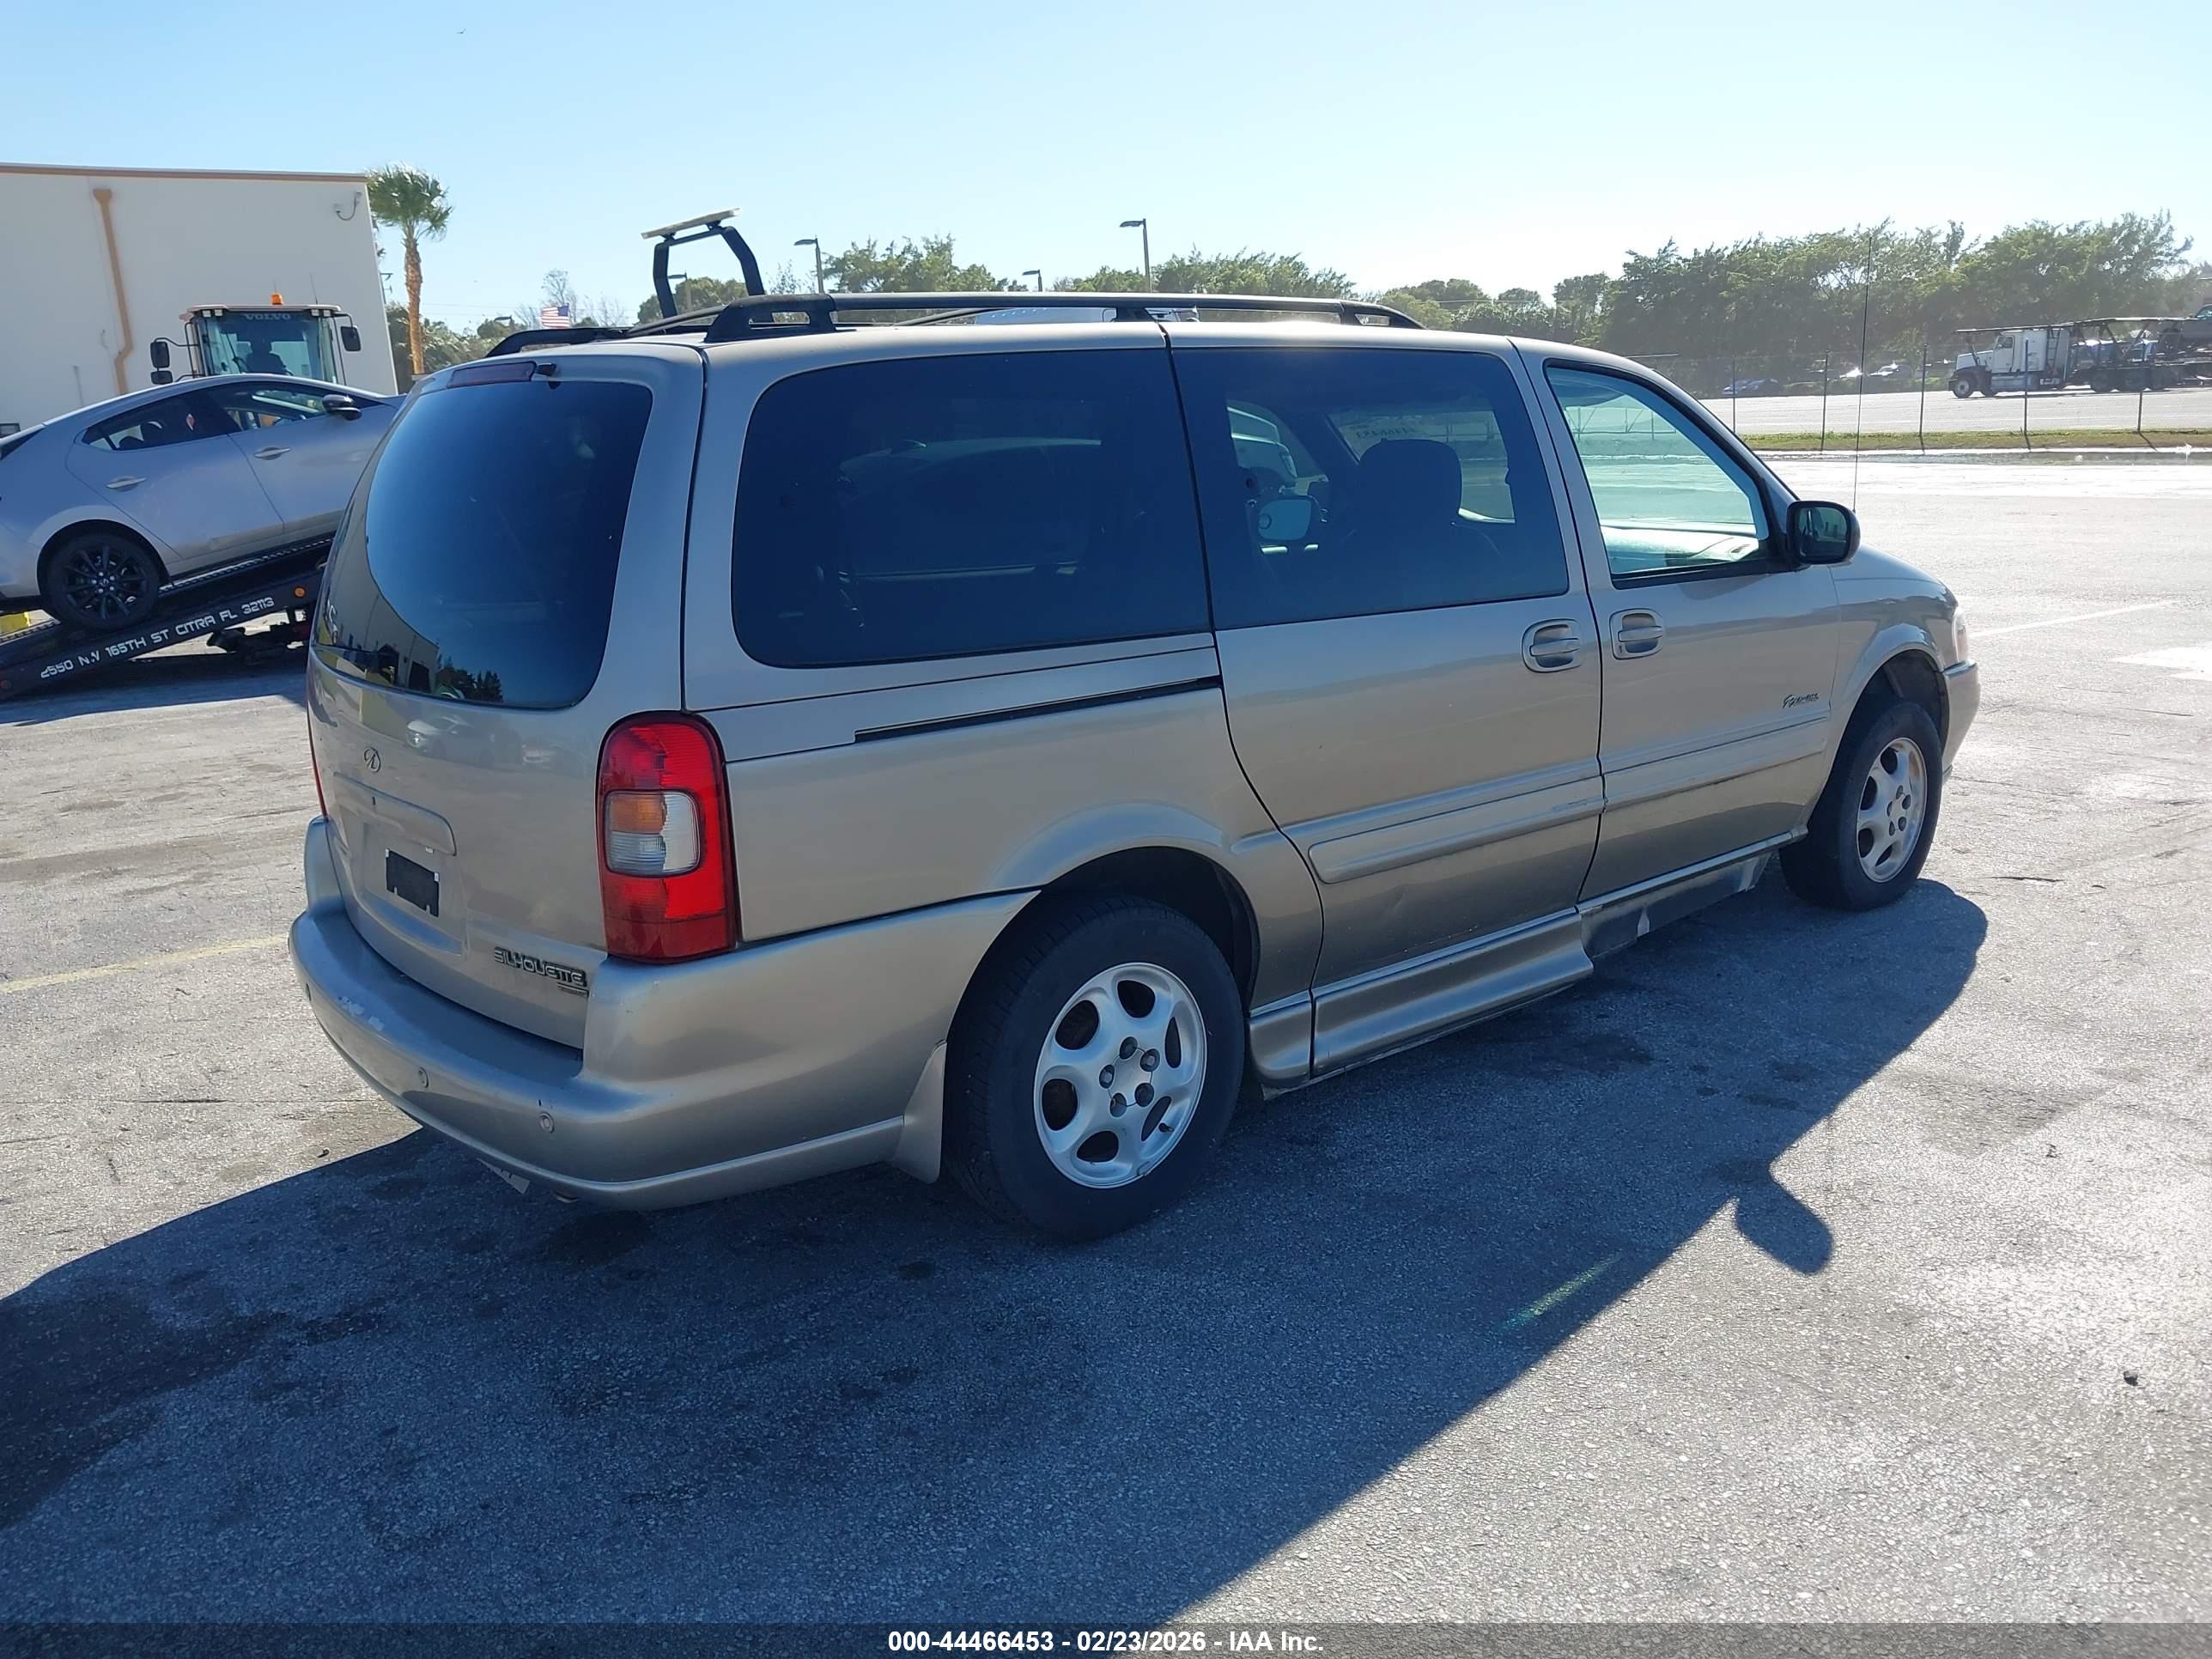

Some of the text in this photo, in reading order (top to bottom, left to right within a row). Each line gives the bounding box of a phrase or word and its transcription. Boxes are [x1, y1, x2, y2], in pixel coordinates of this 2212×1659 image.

[40, 659, 74, 678] 2550
[105, 636, 147, 657] 165TH
[150, 629, 168, 643] ST
[175, 615, 216, 635] CITRA
[219, 609, 238, 623] FL
[241, 597, 275, 615] 32113
[494, 946, 586, 988] SILHOUETTE
